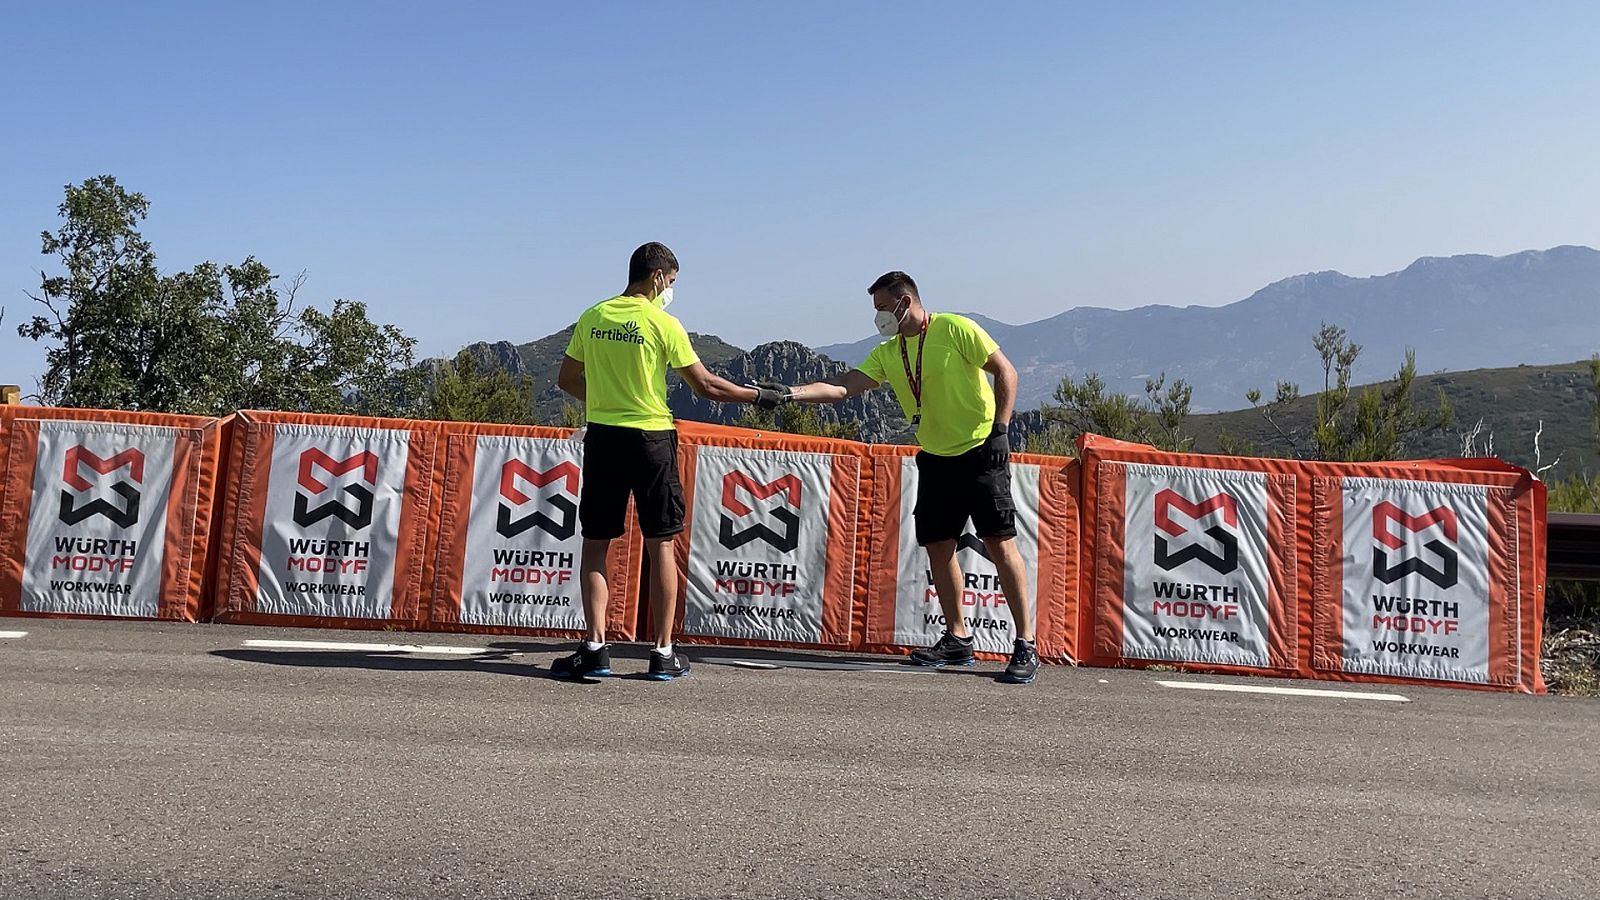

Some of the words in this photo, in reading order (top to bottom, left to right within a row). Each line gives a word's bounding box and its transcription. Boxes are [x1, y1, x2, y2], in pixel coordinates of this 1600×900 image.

[590, 327, 645, 345] Fertiberia
[55, 537, 136, 556] WÜRTH
[289, 538, 369, 557] WÜRTH
[52, 555, 135, 573] MODYF
[287, 556, 367, 574] MODYF
[493, 549, 573, 568] WÜRTH
[491, 567, 571, 585] MODYF
[716, 561, 797, 580] WÜRTH
[50, 580, 132, 594] WORKWEAR
[285, 581, 365, 596] WORKWEAR
[715, 579, 795, 597] MODYF
[1153, 582, 1238, 603] WÜRTH
[489, 593, 570, 607] WORKWEAR
[924, 588, 1006, 608] MDYF
[1372, 595, 1459, 619] WÜRTH
[713, 604, 794, 620] WORKWEAR
[1153, 601, 1238, 620] MODYF
[924, 614, 1008, 631] WOWEAR
[1373, 615, 1459, 635] MODYF
[1152, 627, 1239, 643] WORKWEAR
[1372, 641, 1459, 659] WORKWEAR
